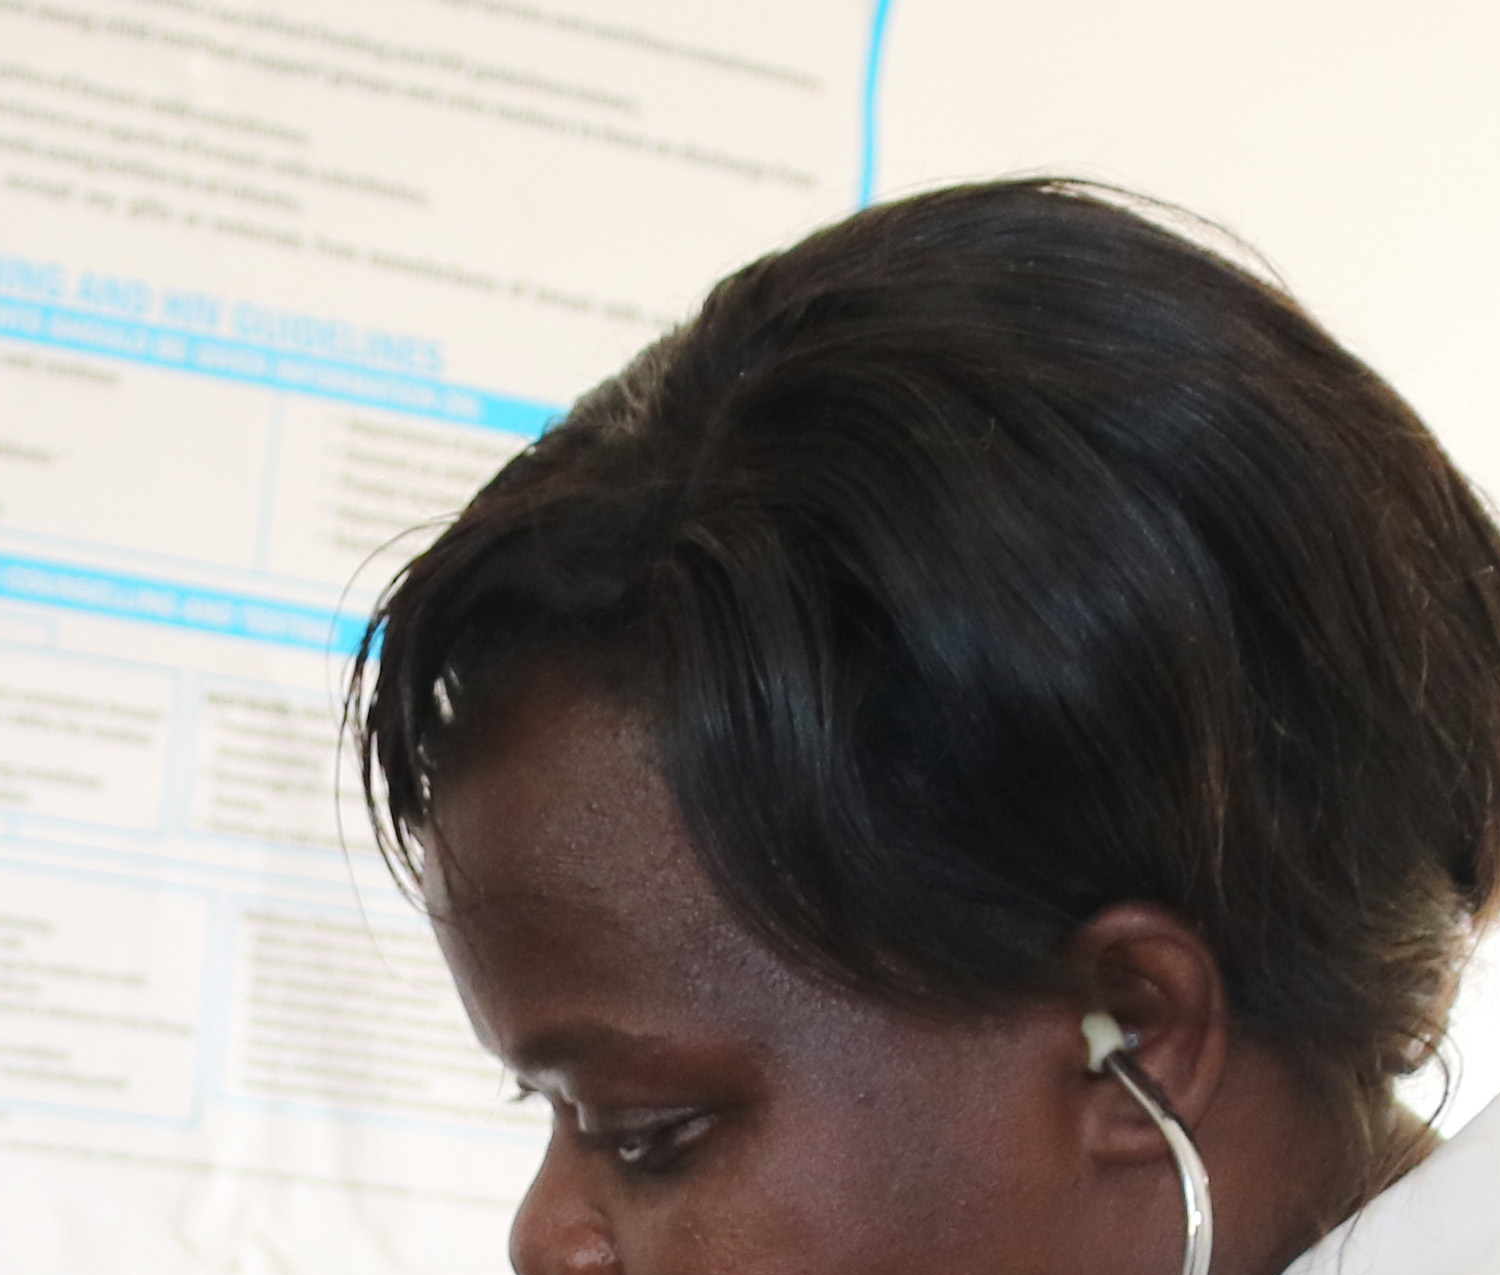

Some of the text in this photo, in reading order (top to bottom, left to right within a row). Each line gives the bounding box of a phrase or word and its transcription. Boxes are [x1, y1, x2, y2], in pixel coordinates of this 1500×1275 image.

[74, 267, 152, 321] AND
[161, 286, 221, 333] HIV
[230, 298, 446, 376] GUIDELINES
